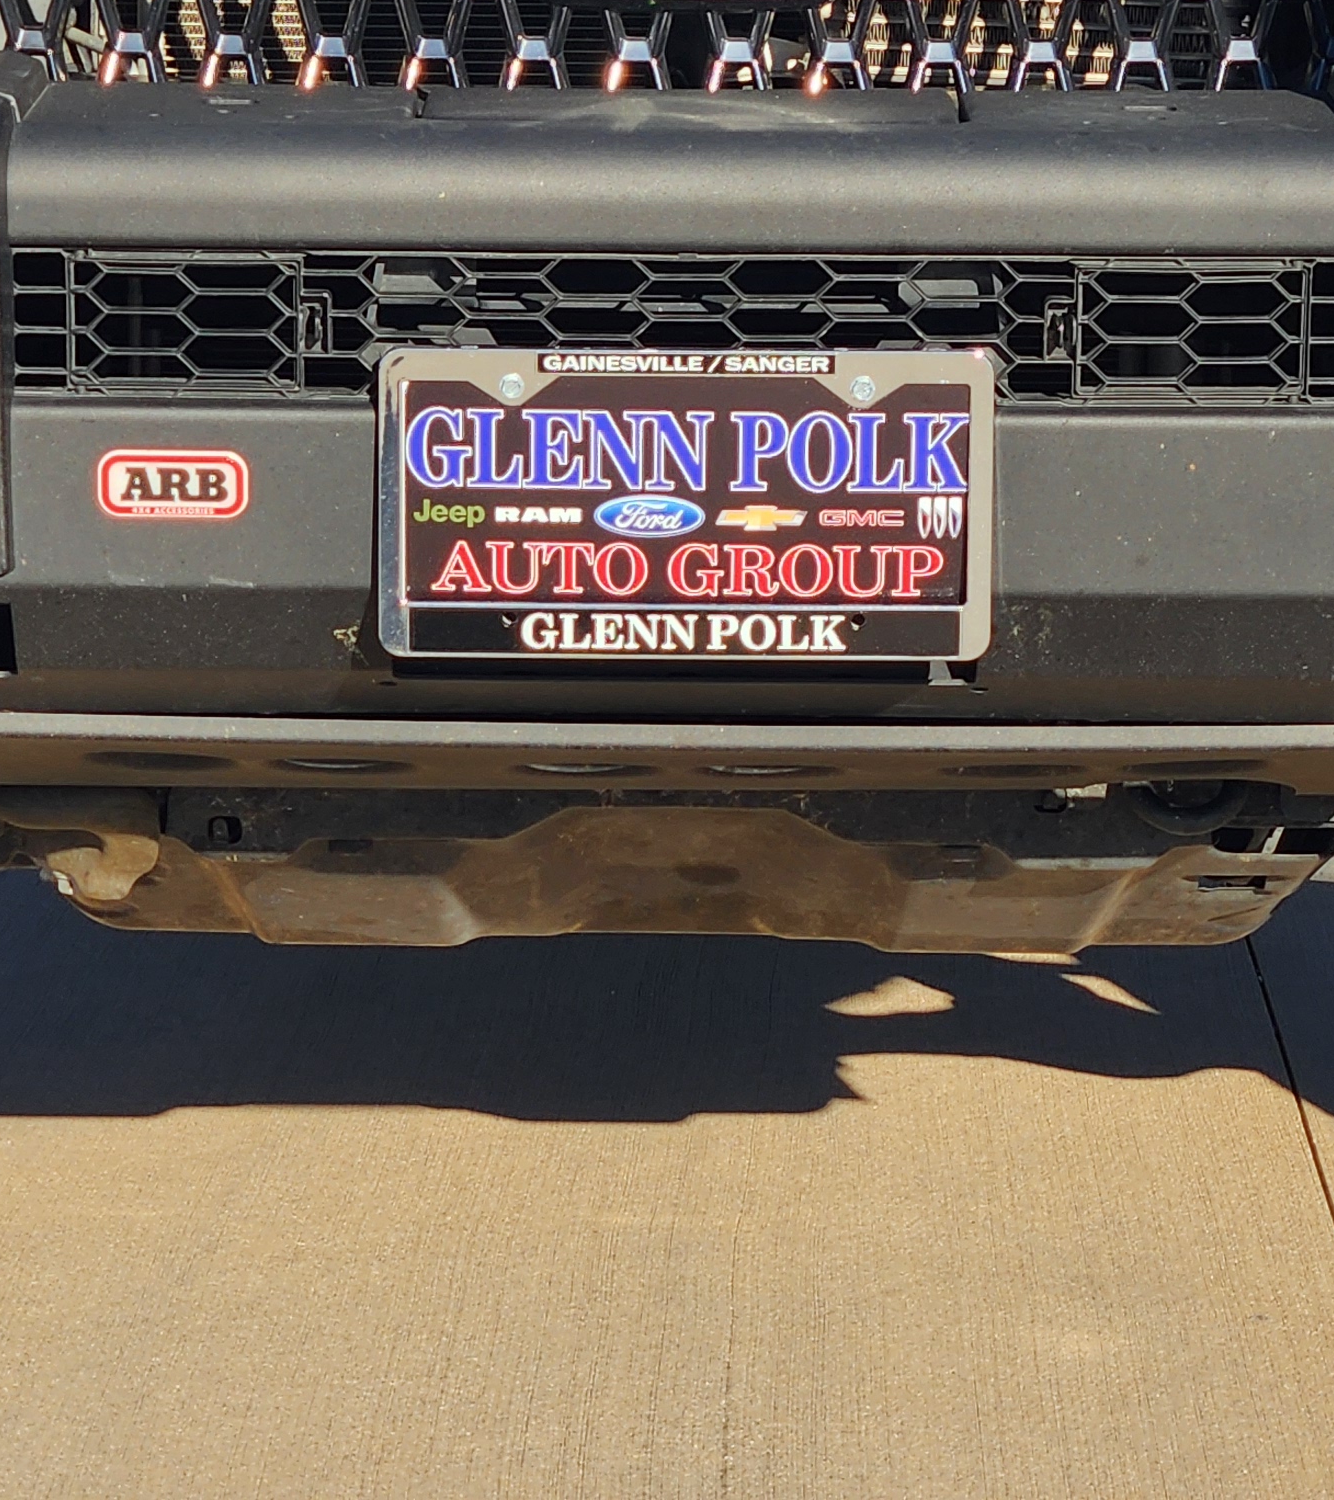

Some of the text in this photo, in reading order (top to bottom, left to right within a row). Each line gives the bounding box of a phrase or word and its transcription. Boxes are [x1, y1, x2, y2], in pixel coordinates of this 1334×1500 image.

[542, 354, 704, 372] GAINESVILLE
[724, 355, 830, 373] SANGER
[405, 407, 970, 495] GLENN POLK
[119, 466, 229, 502] ARB
[154, 507, 216, 516] ACCESSORIES
[413, 499, 905, 530] Jeep RAM Ford GMC
[431, 540, 944, 598] AUTO GROUP
[520, 612, 848, 653] GLENN POLK
